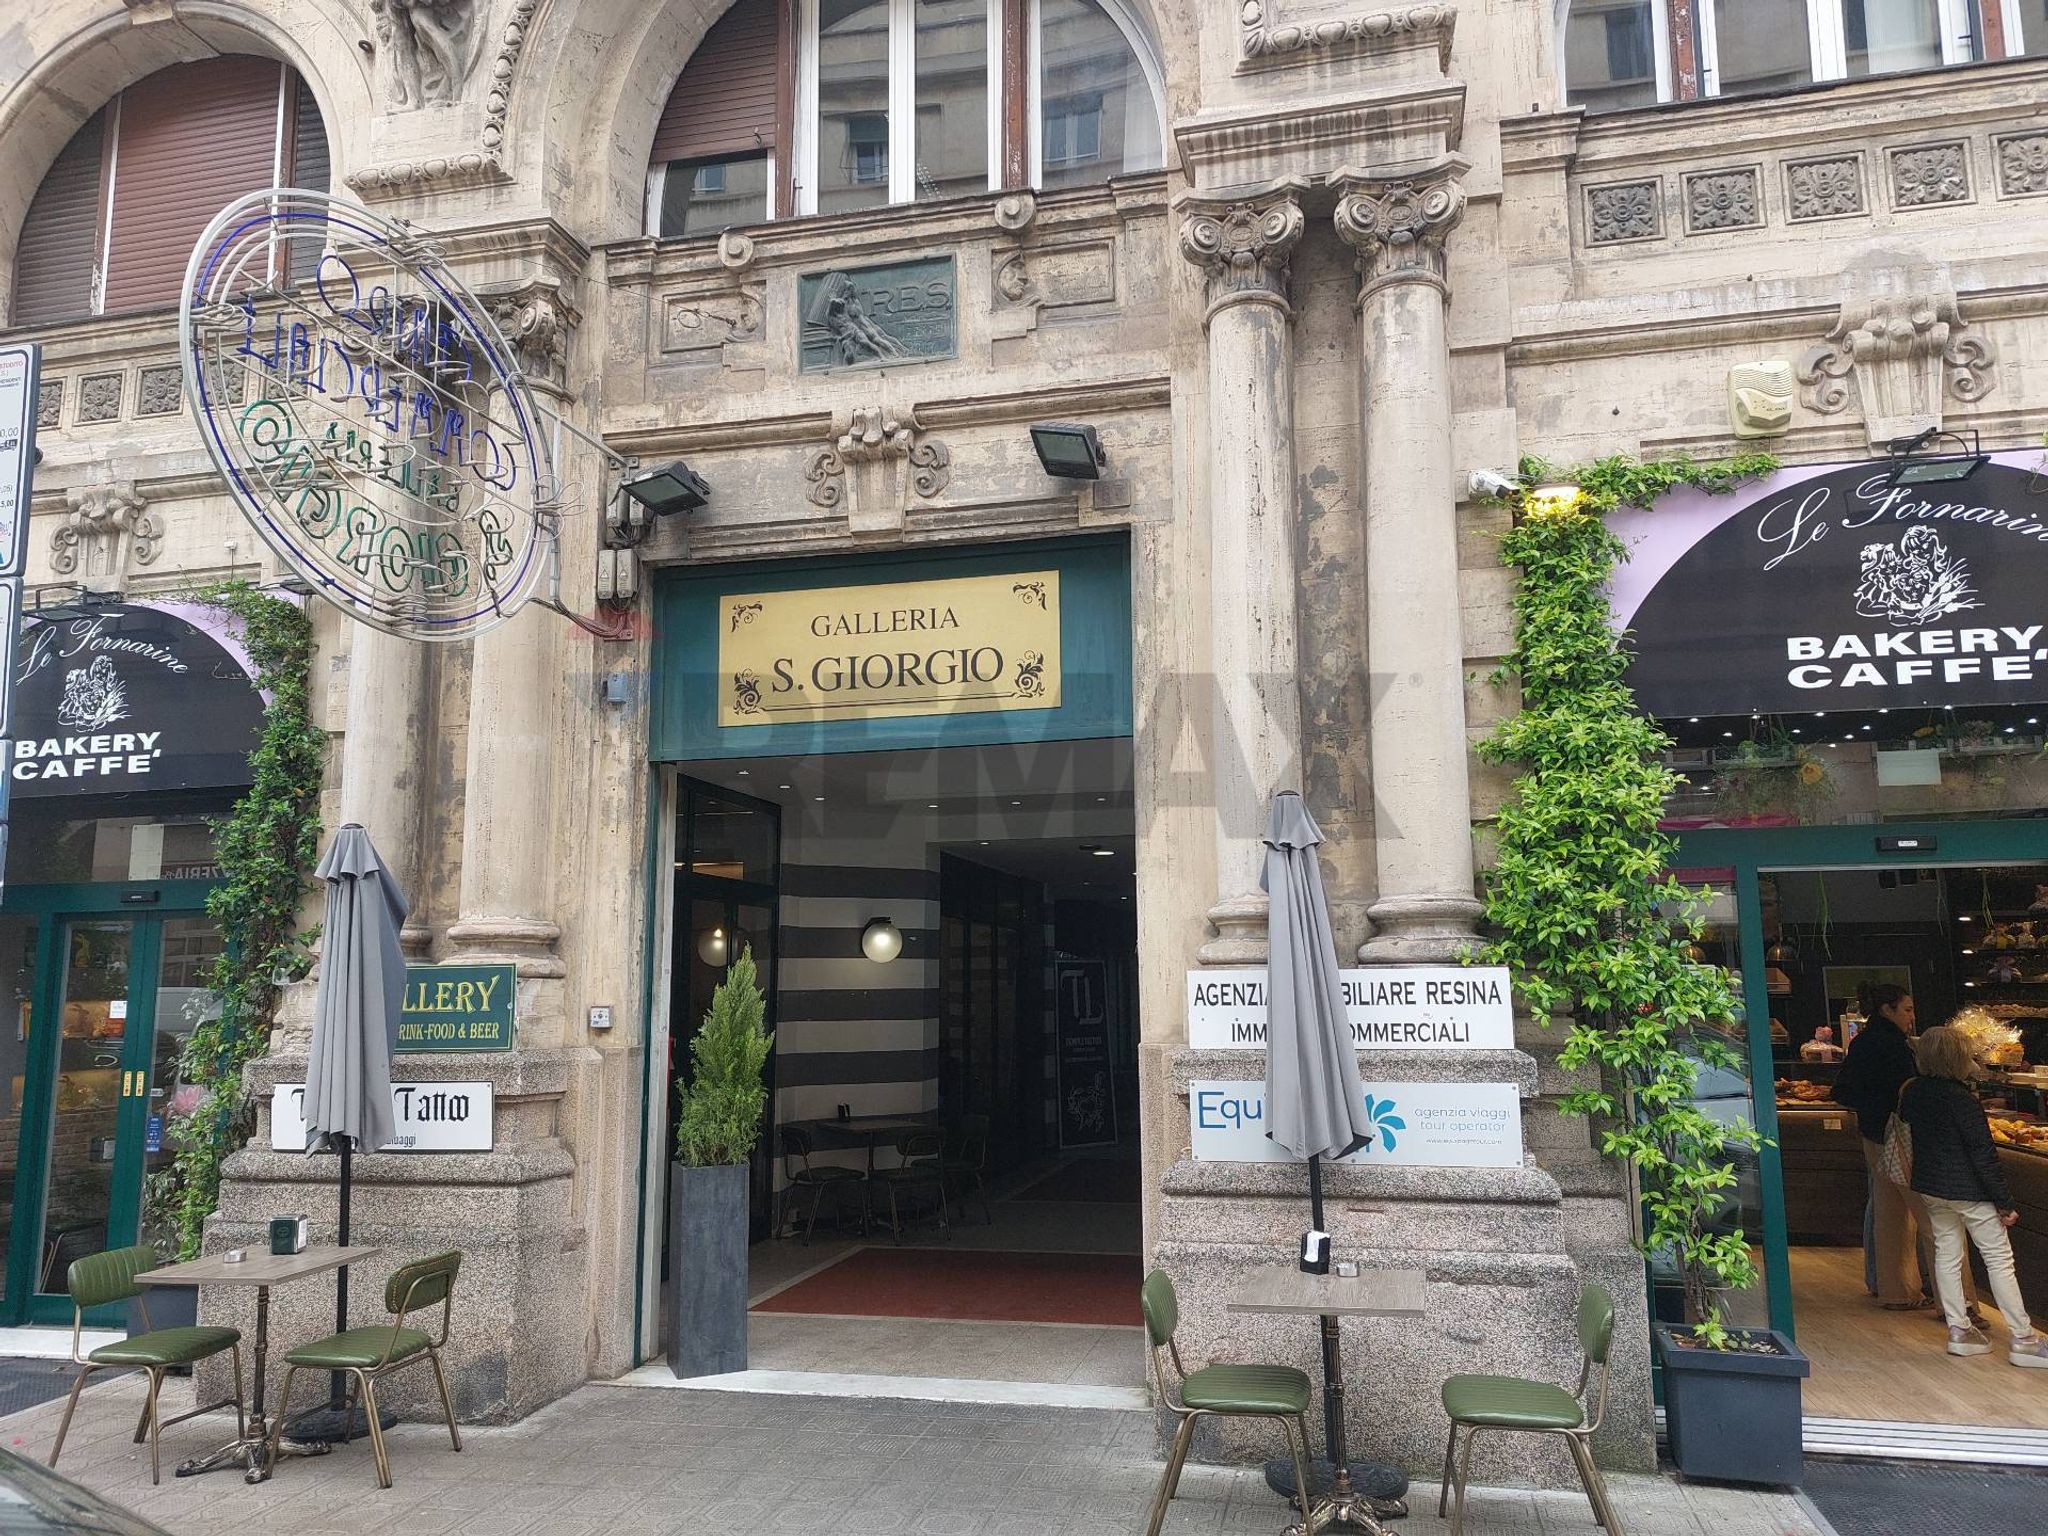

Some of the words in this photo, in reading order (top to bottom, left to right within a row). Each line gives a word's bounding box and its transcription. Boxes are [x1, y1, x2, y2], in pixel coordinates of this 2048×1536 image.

[1757, 487, 1831, 571] Le
[811, 606, 960, 638] GALLERIA
[16, 625, 57, 686] Le
[59, 613, 188, 675] Fornarine
[1786, 624, 2044, 660] BAKERY
[771, 657, 805, 693] S.
[811, 646, 1004, 692] GIORGIO
[14, 731, 162, 759] BAKERY
[402, 974, 500, 1015] LLERY
[1193, 982, 1268, 1007] AGENZI
[1341, 981, 1417, 1006] BILIARE
[1426, 980, 1503, 1006] RESINA
[398, 1022, 456, 1041] RINK-FOOD
[458, 1022, 467, 1039] &
[469, 1021, 500, 1040] BEER
[1231, 1022, 1268, 1042] IMM
[1349, 1022, 1470, 1043] MMERCIALI
[1198, 1091, 1263, 1129] Equ
[1415, 1107, 1466, 1119] agenzia
[1469, 1107, 1512, 1121] viaggi
[1420, 1120, 1446, 1131] tour
[1450, 1121, 1506, 1133] operator
